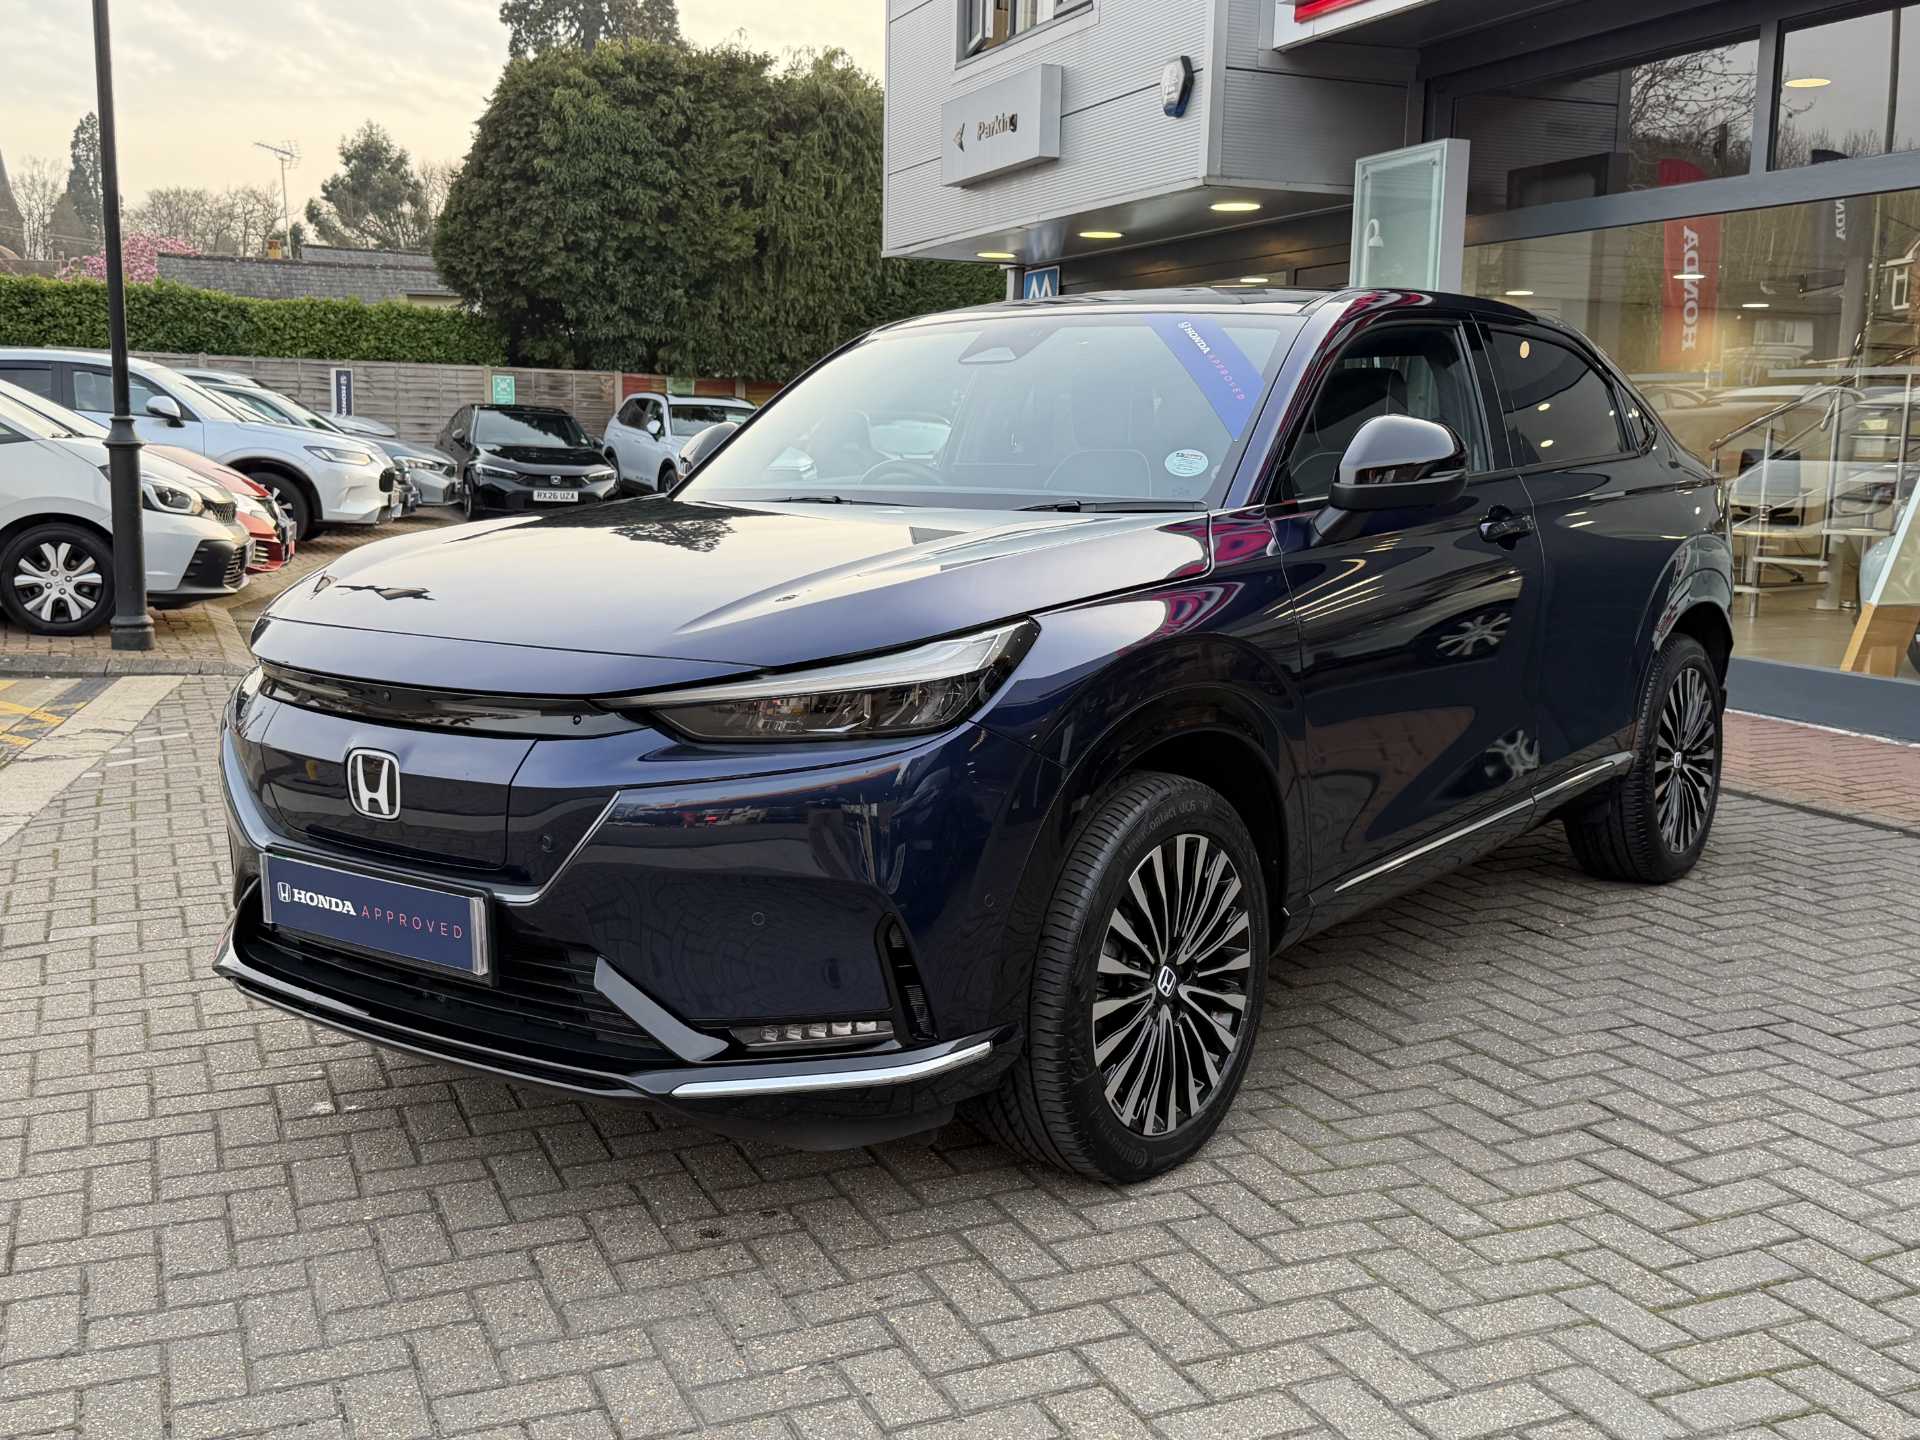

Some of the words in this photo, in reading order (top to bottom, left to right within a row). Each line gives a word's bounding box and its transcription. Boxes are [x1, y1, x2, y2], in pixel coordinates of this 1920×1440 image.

[977, 112, 1018, 141] Parking
[1183, 327, 1210, 354] HONDA
[1206, 353, 1246, 400] APPROVED
[292, 888, 357, 916] HONDA
[361, 905, 463, 939] APPROVED
